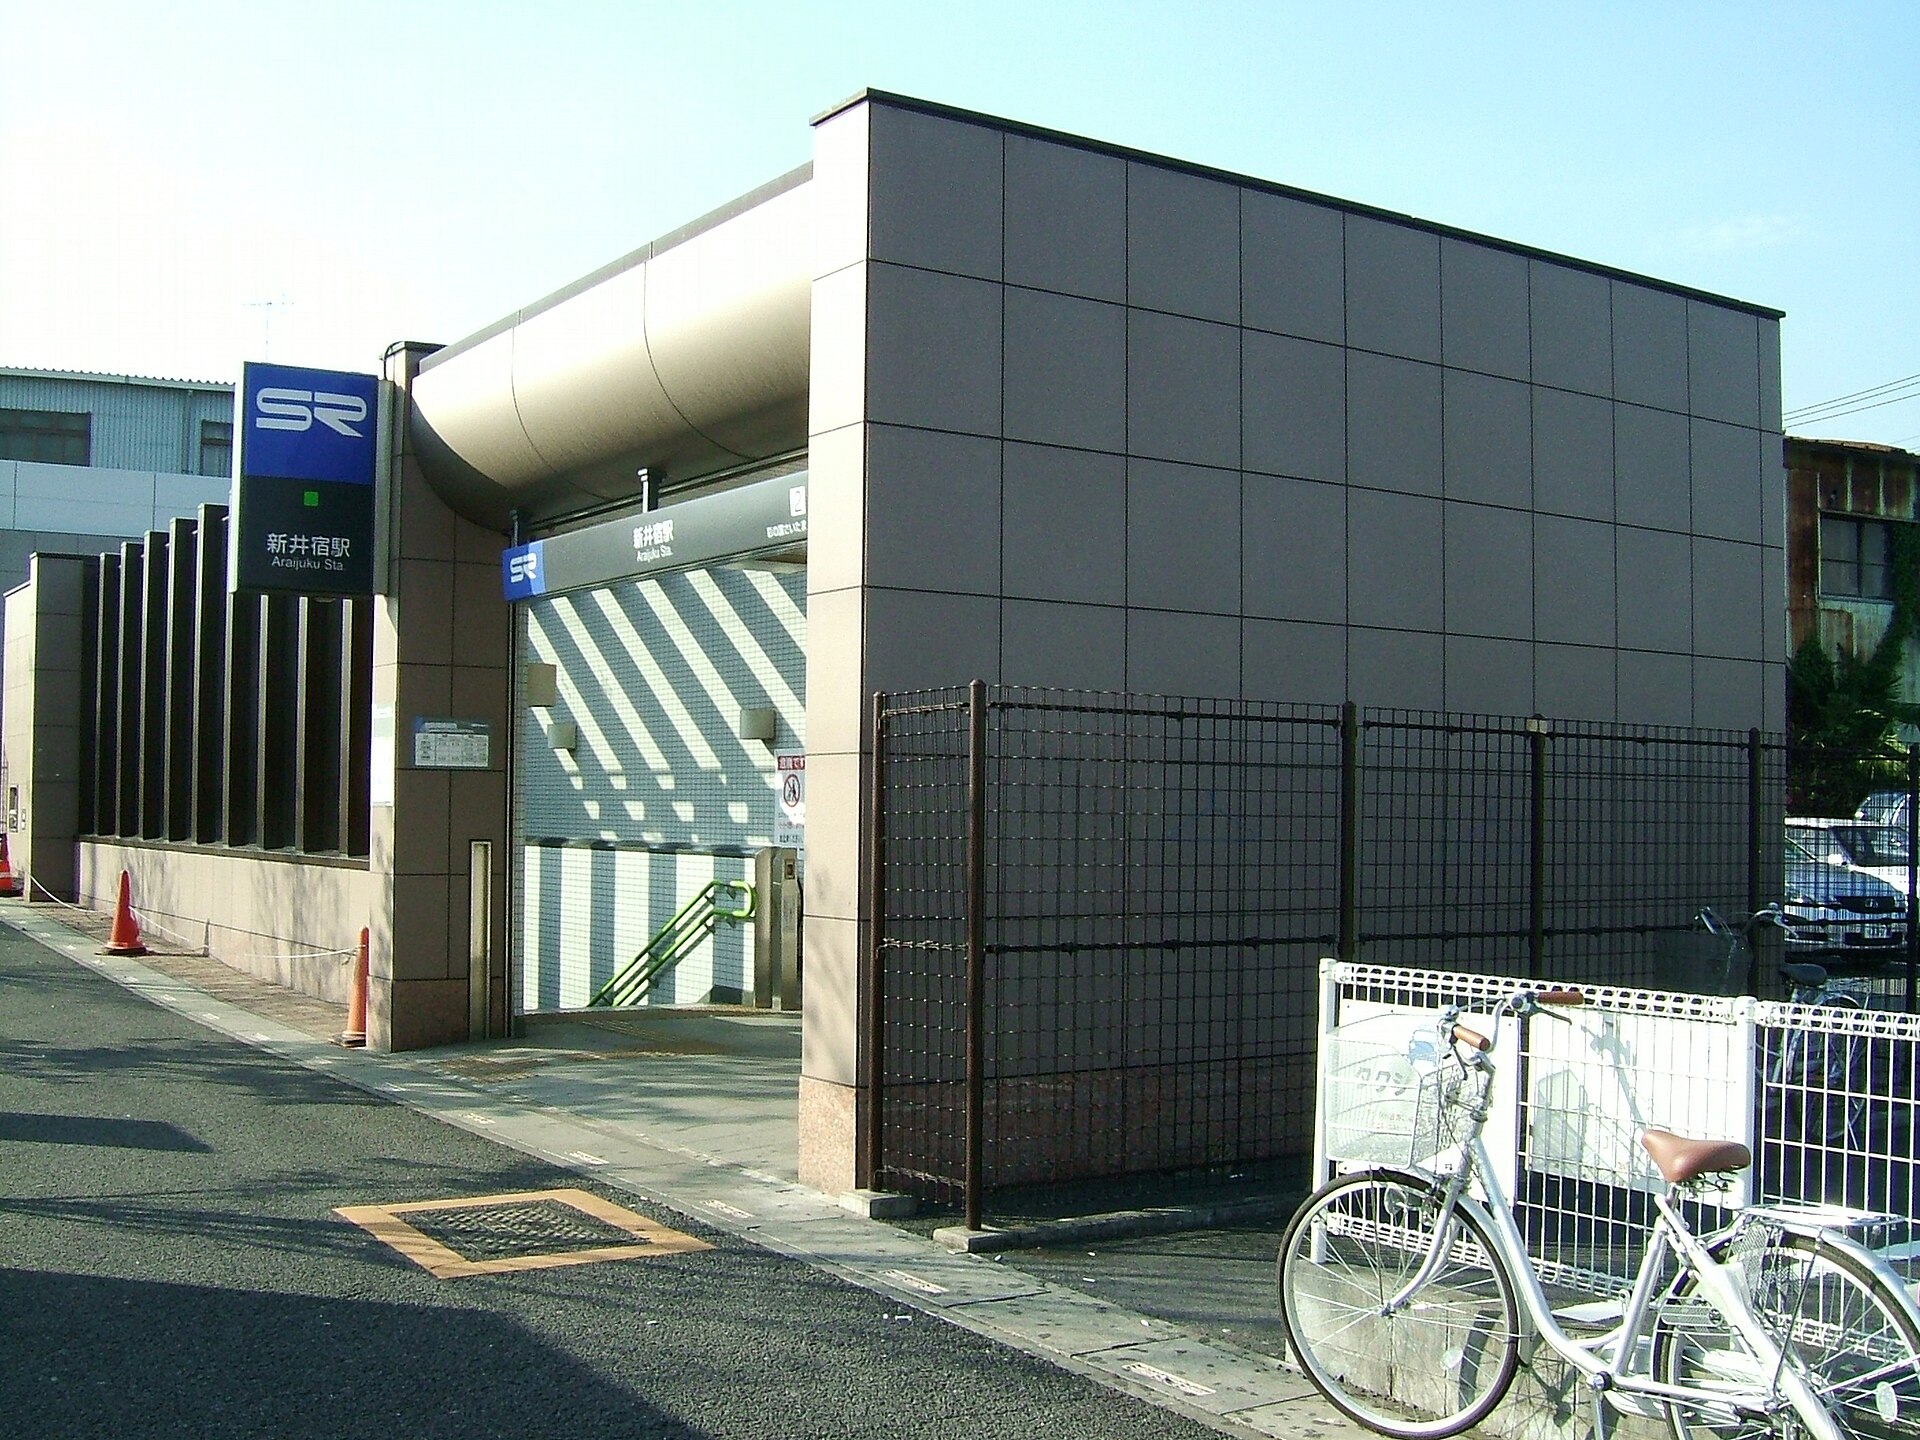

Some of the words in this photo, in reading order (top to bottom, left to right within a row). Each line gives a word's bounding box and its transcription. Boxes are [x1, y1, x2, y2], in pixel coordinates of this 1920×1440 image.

[256, 388, 367, 437] SR
[794, 491, 802, 513] 2
[266, 532, 350, 558] 新井宿駅
[634, 519, 673, 549] 新井宿駅
[271, 555, 321, 571] Araijuku
[510, 552, 537, 583] SR
